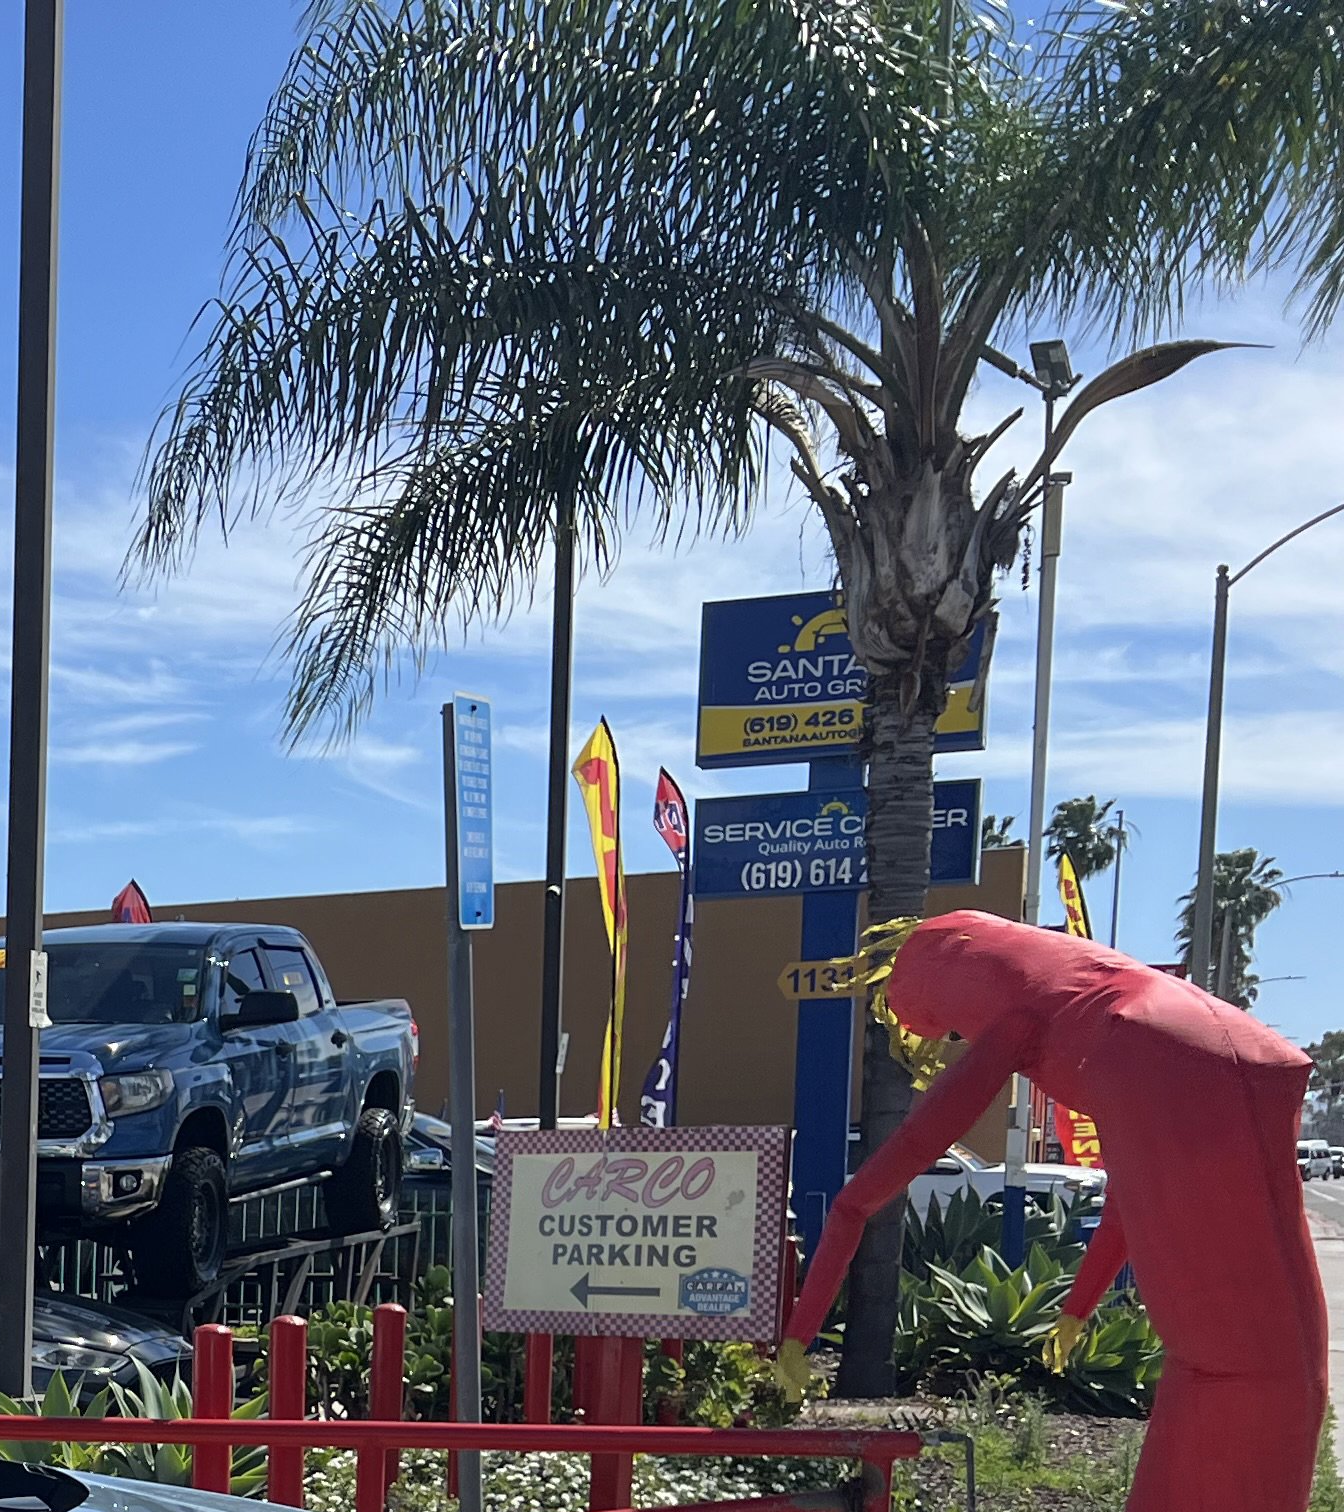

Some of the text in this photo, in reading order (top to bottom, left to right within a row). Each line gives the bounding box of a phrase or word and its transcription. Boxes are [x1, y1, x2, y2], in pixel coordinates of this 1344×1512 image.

[747, 654, 869, 683] SANTA
[754, 682, 822, 701] AUTO
[743, 713, 798, 736] (619)
[805, 708, 854, 728] 426
[742, 727, 864, 748] SANTANAAUTOG
[703, 817, 834, 843] SERVICE
[758, 838, 812, 856] Quality
[814, 837, 850, 851] Auto
[741, 859, 802, 890] (619)
[809, 856, 853, 886] 614
[541, 1155, 716, 1208] CARCO
[538, 1214, 718, 1239] CUSTOMER
[552, 1243, 697, 1268] PARKING
